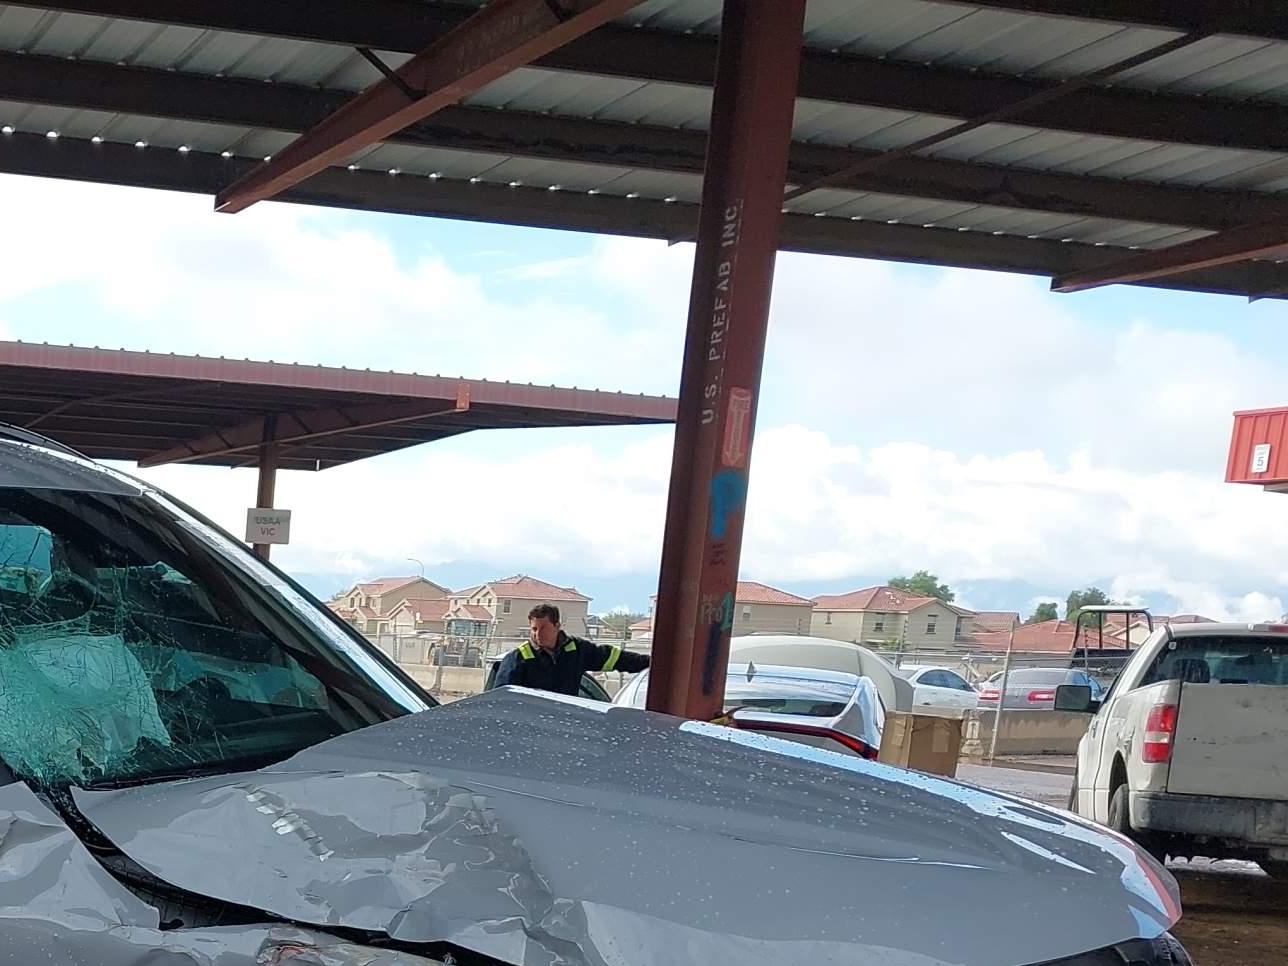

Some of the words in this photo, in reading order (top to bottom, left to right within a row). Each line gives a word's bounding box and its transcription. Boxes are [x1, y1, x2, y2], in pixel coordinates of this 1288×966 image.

[709, 261, 731, 361] PREFAB
[702, 375, 718, 424] U.S.
[260, 527, 276, 536] VIC
[711, 469, 746, 538] P
